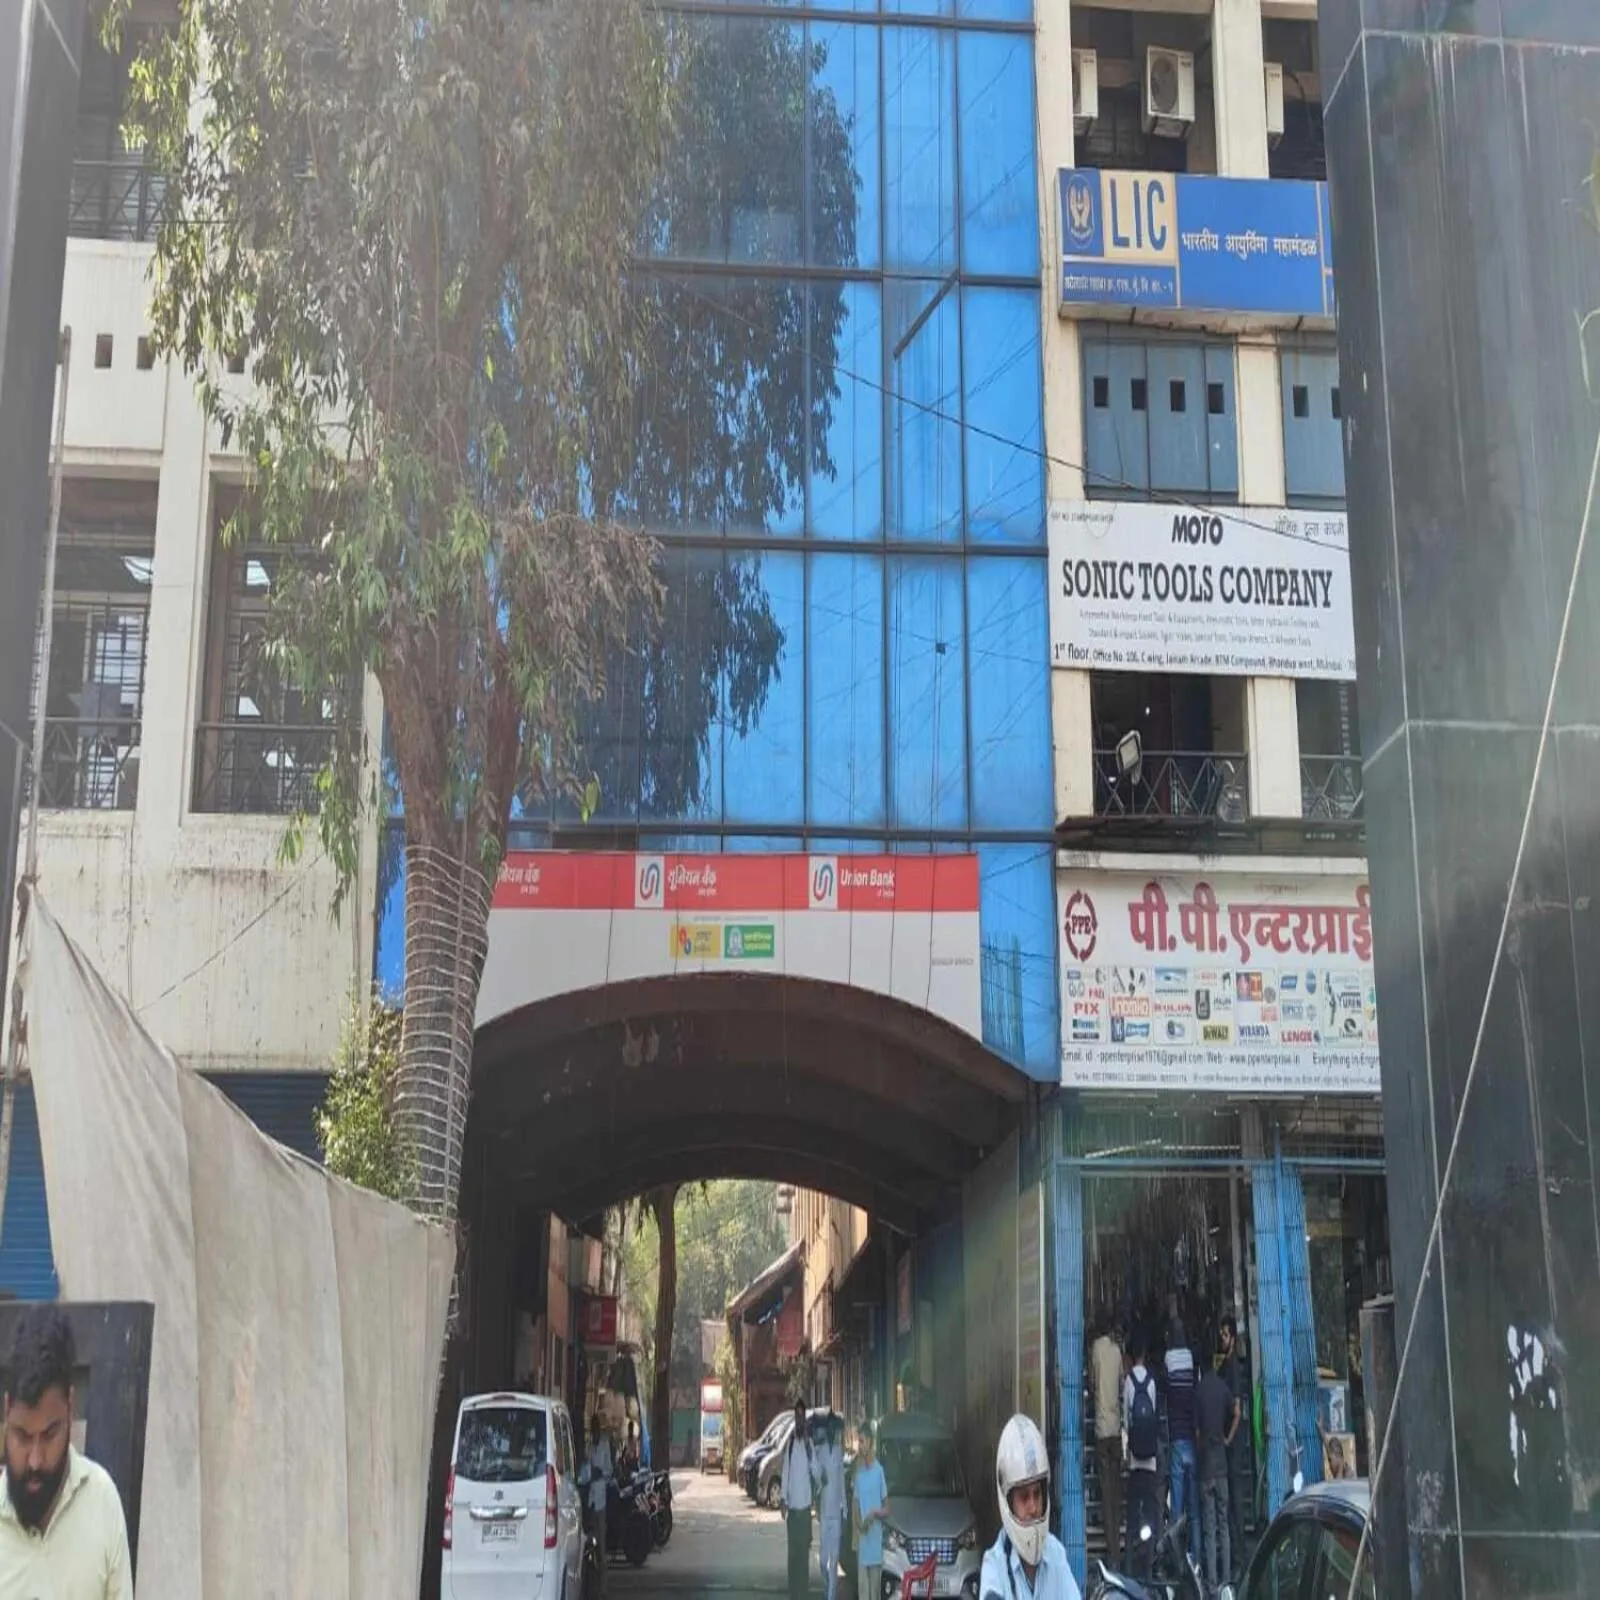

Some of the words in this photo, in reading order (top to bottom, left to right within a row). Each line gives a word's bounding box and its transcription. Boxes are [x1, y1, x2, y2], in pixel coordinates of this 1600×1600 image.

[1109, 179, 1167, 250] LIC
[1171, 515, 1223, 545] MOTO
[1062, 559, 1135, 600] SONIC
[1138, 562, 1213, 604] TOOLS
[1219, 565, 1333, 608] COMPANY
[840, 868, 868, 886] Union
[869, 869, 895, 887] Bank
[1071, 914, 1091, 935] PPE
[1074, 1003, 1099, 1014] PIX
